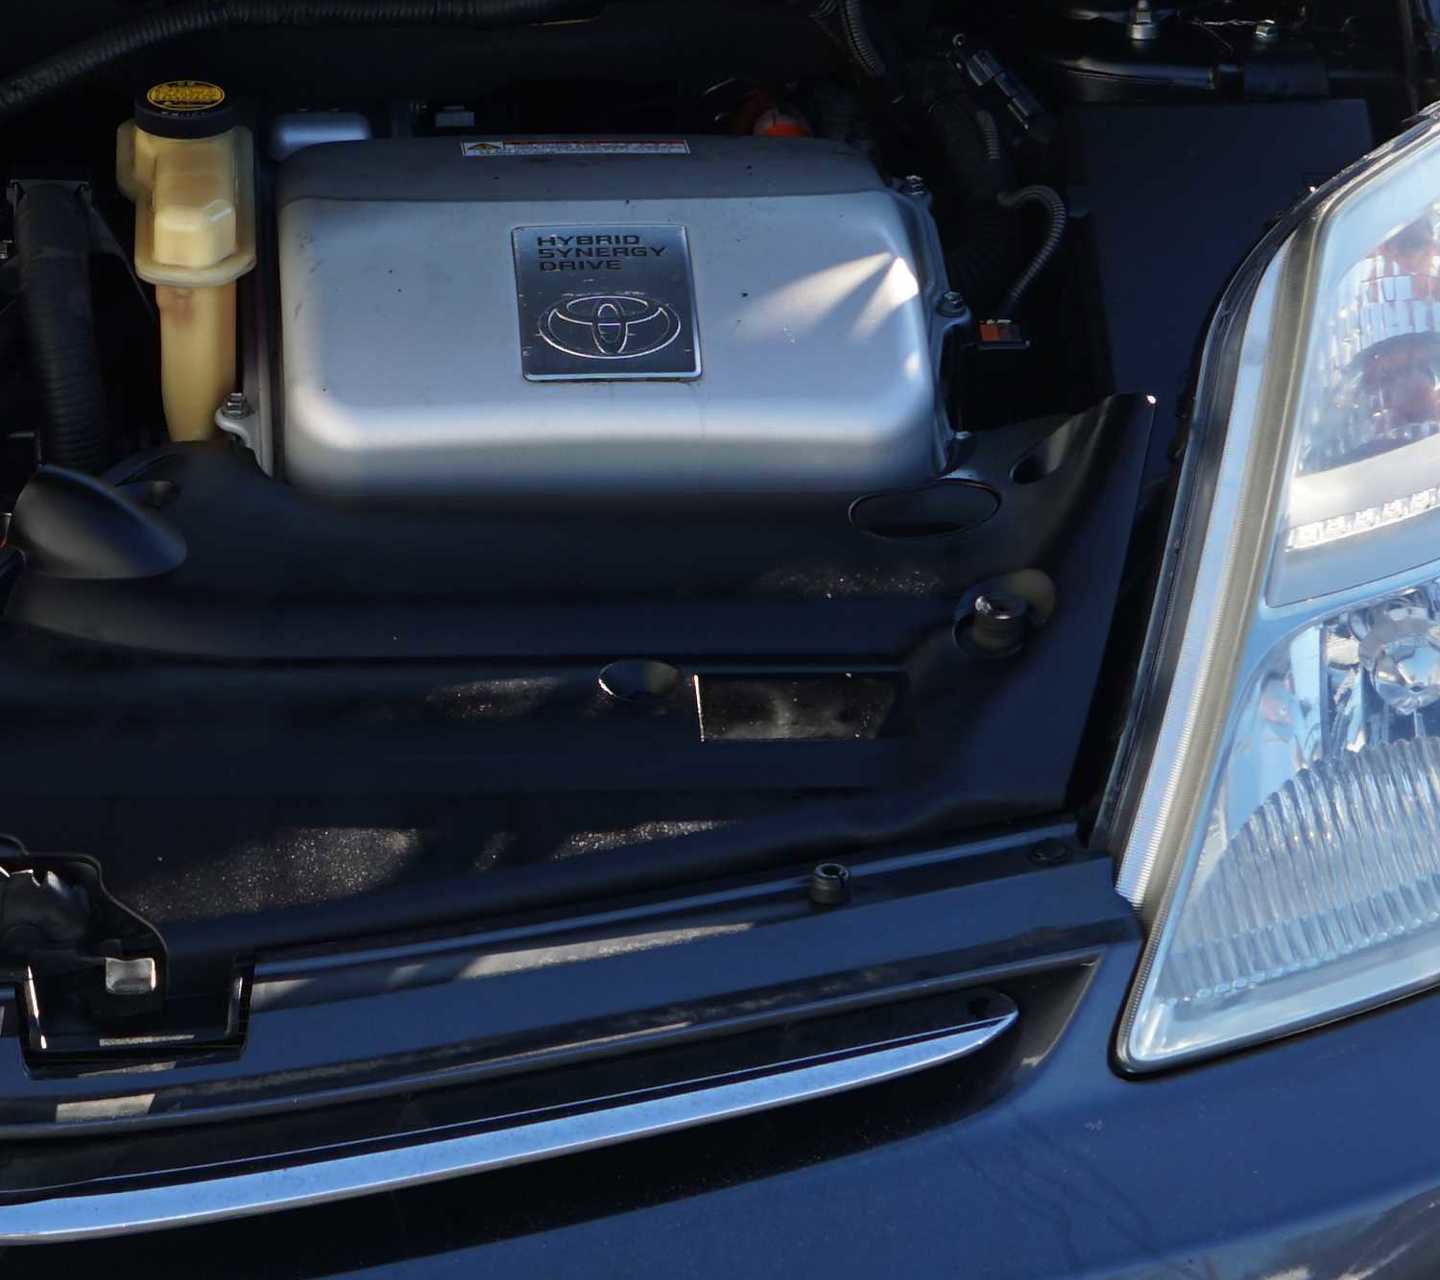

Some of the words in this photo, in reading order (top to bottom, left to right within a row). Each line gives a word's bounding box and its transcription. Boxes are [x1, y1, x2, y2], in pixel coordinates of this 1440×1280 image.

[537, 234, 640, 246] HYBRID
[538, 246, 665, 259] SYNERGY
[539, 259, 624, 271] DRIVE
